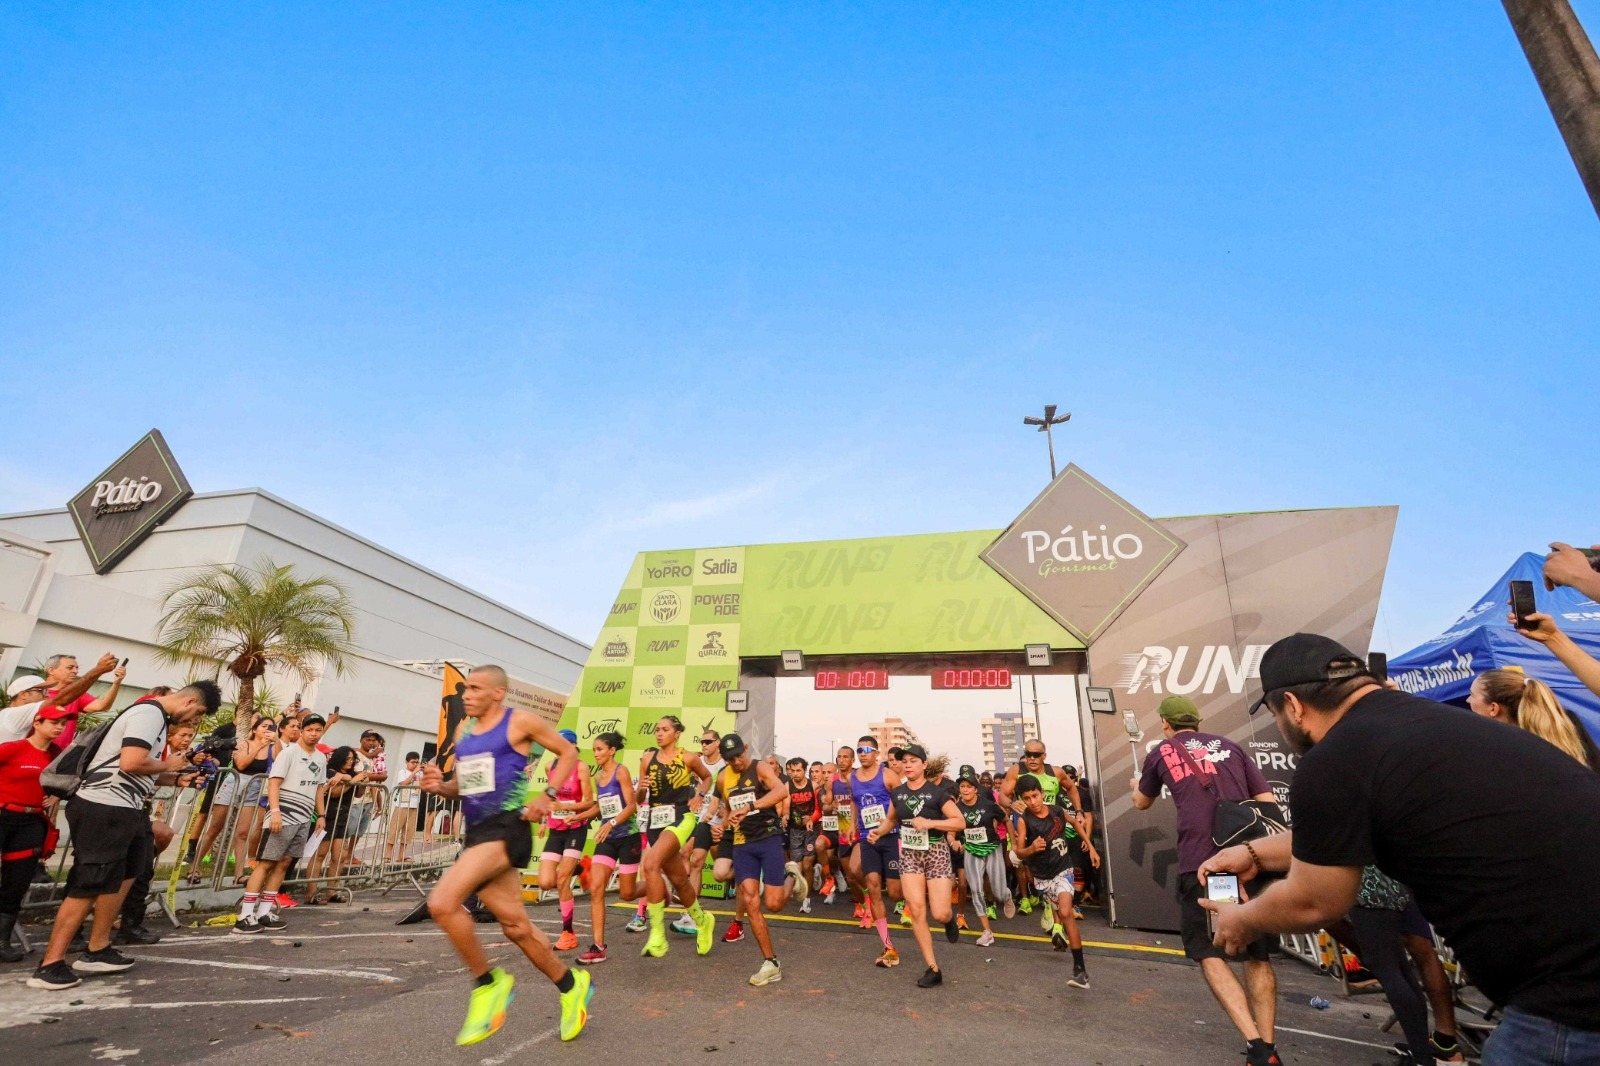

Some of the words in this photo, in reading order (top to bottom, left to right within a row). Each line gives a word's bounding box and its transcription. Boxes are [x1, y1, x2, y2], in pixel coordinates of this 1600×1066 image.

[91, 476, 162, 507] Pátio
[1021, 524, 1143, 563] Pátio
[702, 558, 737, 576] Sadia
[916, 540, 990, 582] RU
[1039, 558, 1118, 578] Gourmet
[647, 565, 692, 579] YoPRO
[694, 593, 740, 606] POWER
[714, 605, 740, 616] ADE
[698, 650, 728, 658] QUAKER
[1394, 648, 1475, 694] naus.com.br
[582, 718, 622, 739] Secret
[638, 722, 658, 735] RU
[1250, 752, 1297, 770] PRO
[905, 835, 923, 843] 1395
